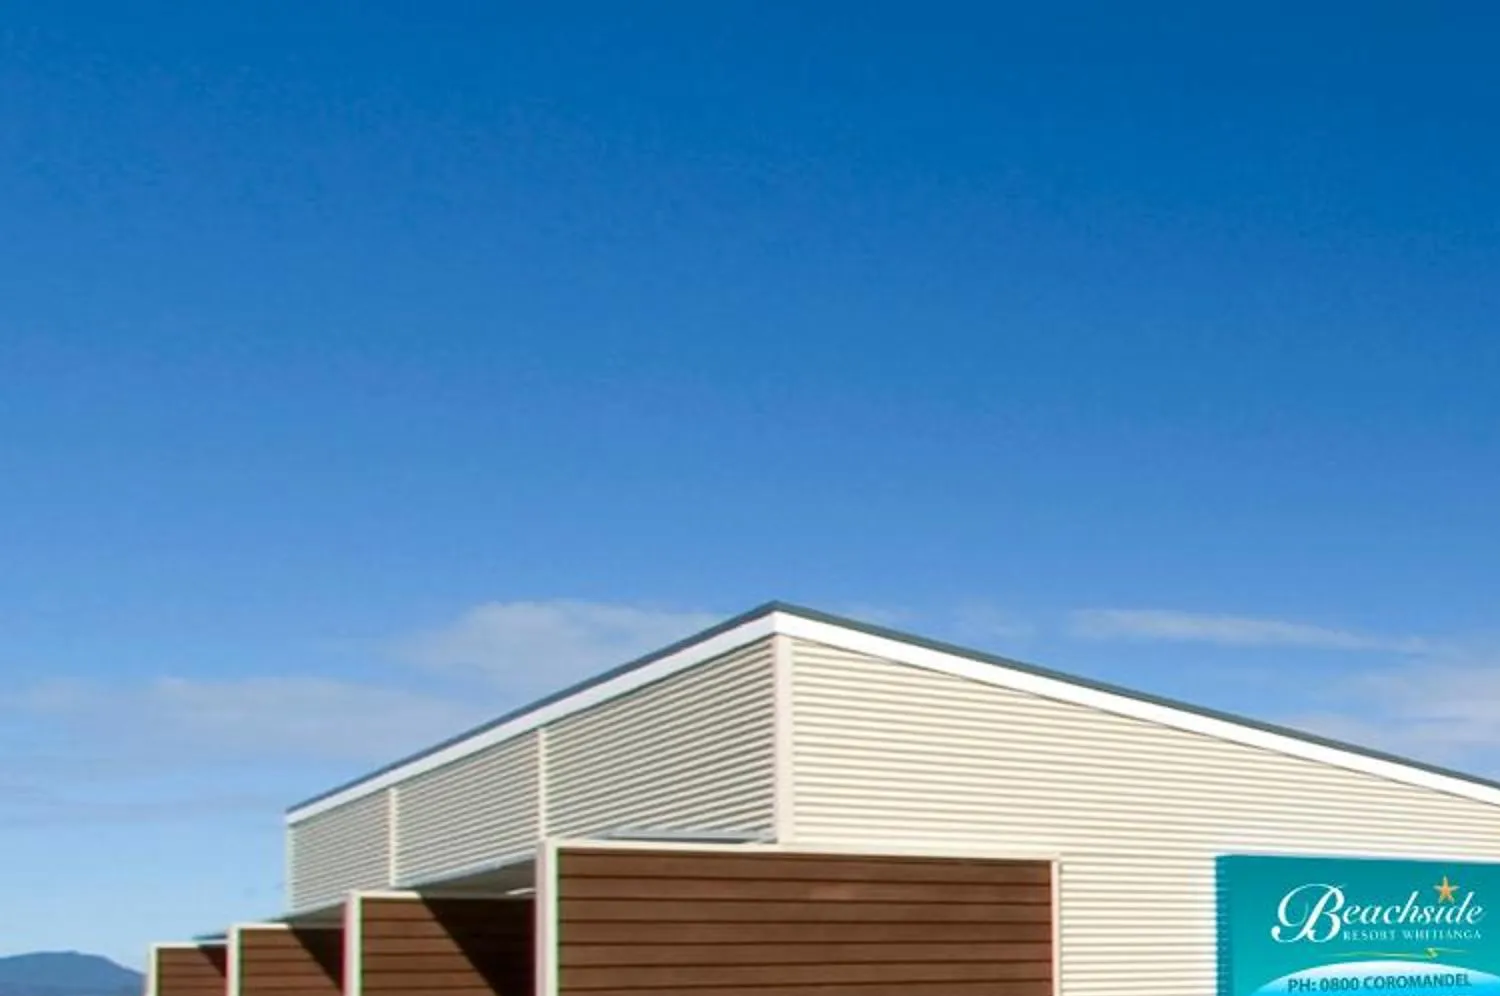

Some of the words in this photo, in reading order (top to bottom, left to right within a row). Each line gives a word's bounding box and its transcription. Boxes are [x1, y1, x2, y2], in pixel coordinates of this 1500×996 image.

[1271, 883, 1485, 943] Beachside
[1343, 929, 1396, 941] RESORT
[1287, 978, 1317, 993] PH:
[1320, 977, 1358, 992] 0800
[1363, 973, 1472, 990] COROMANDEL
